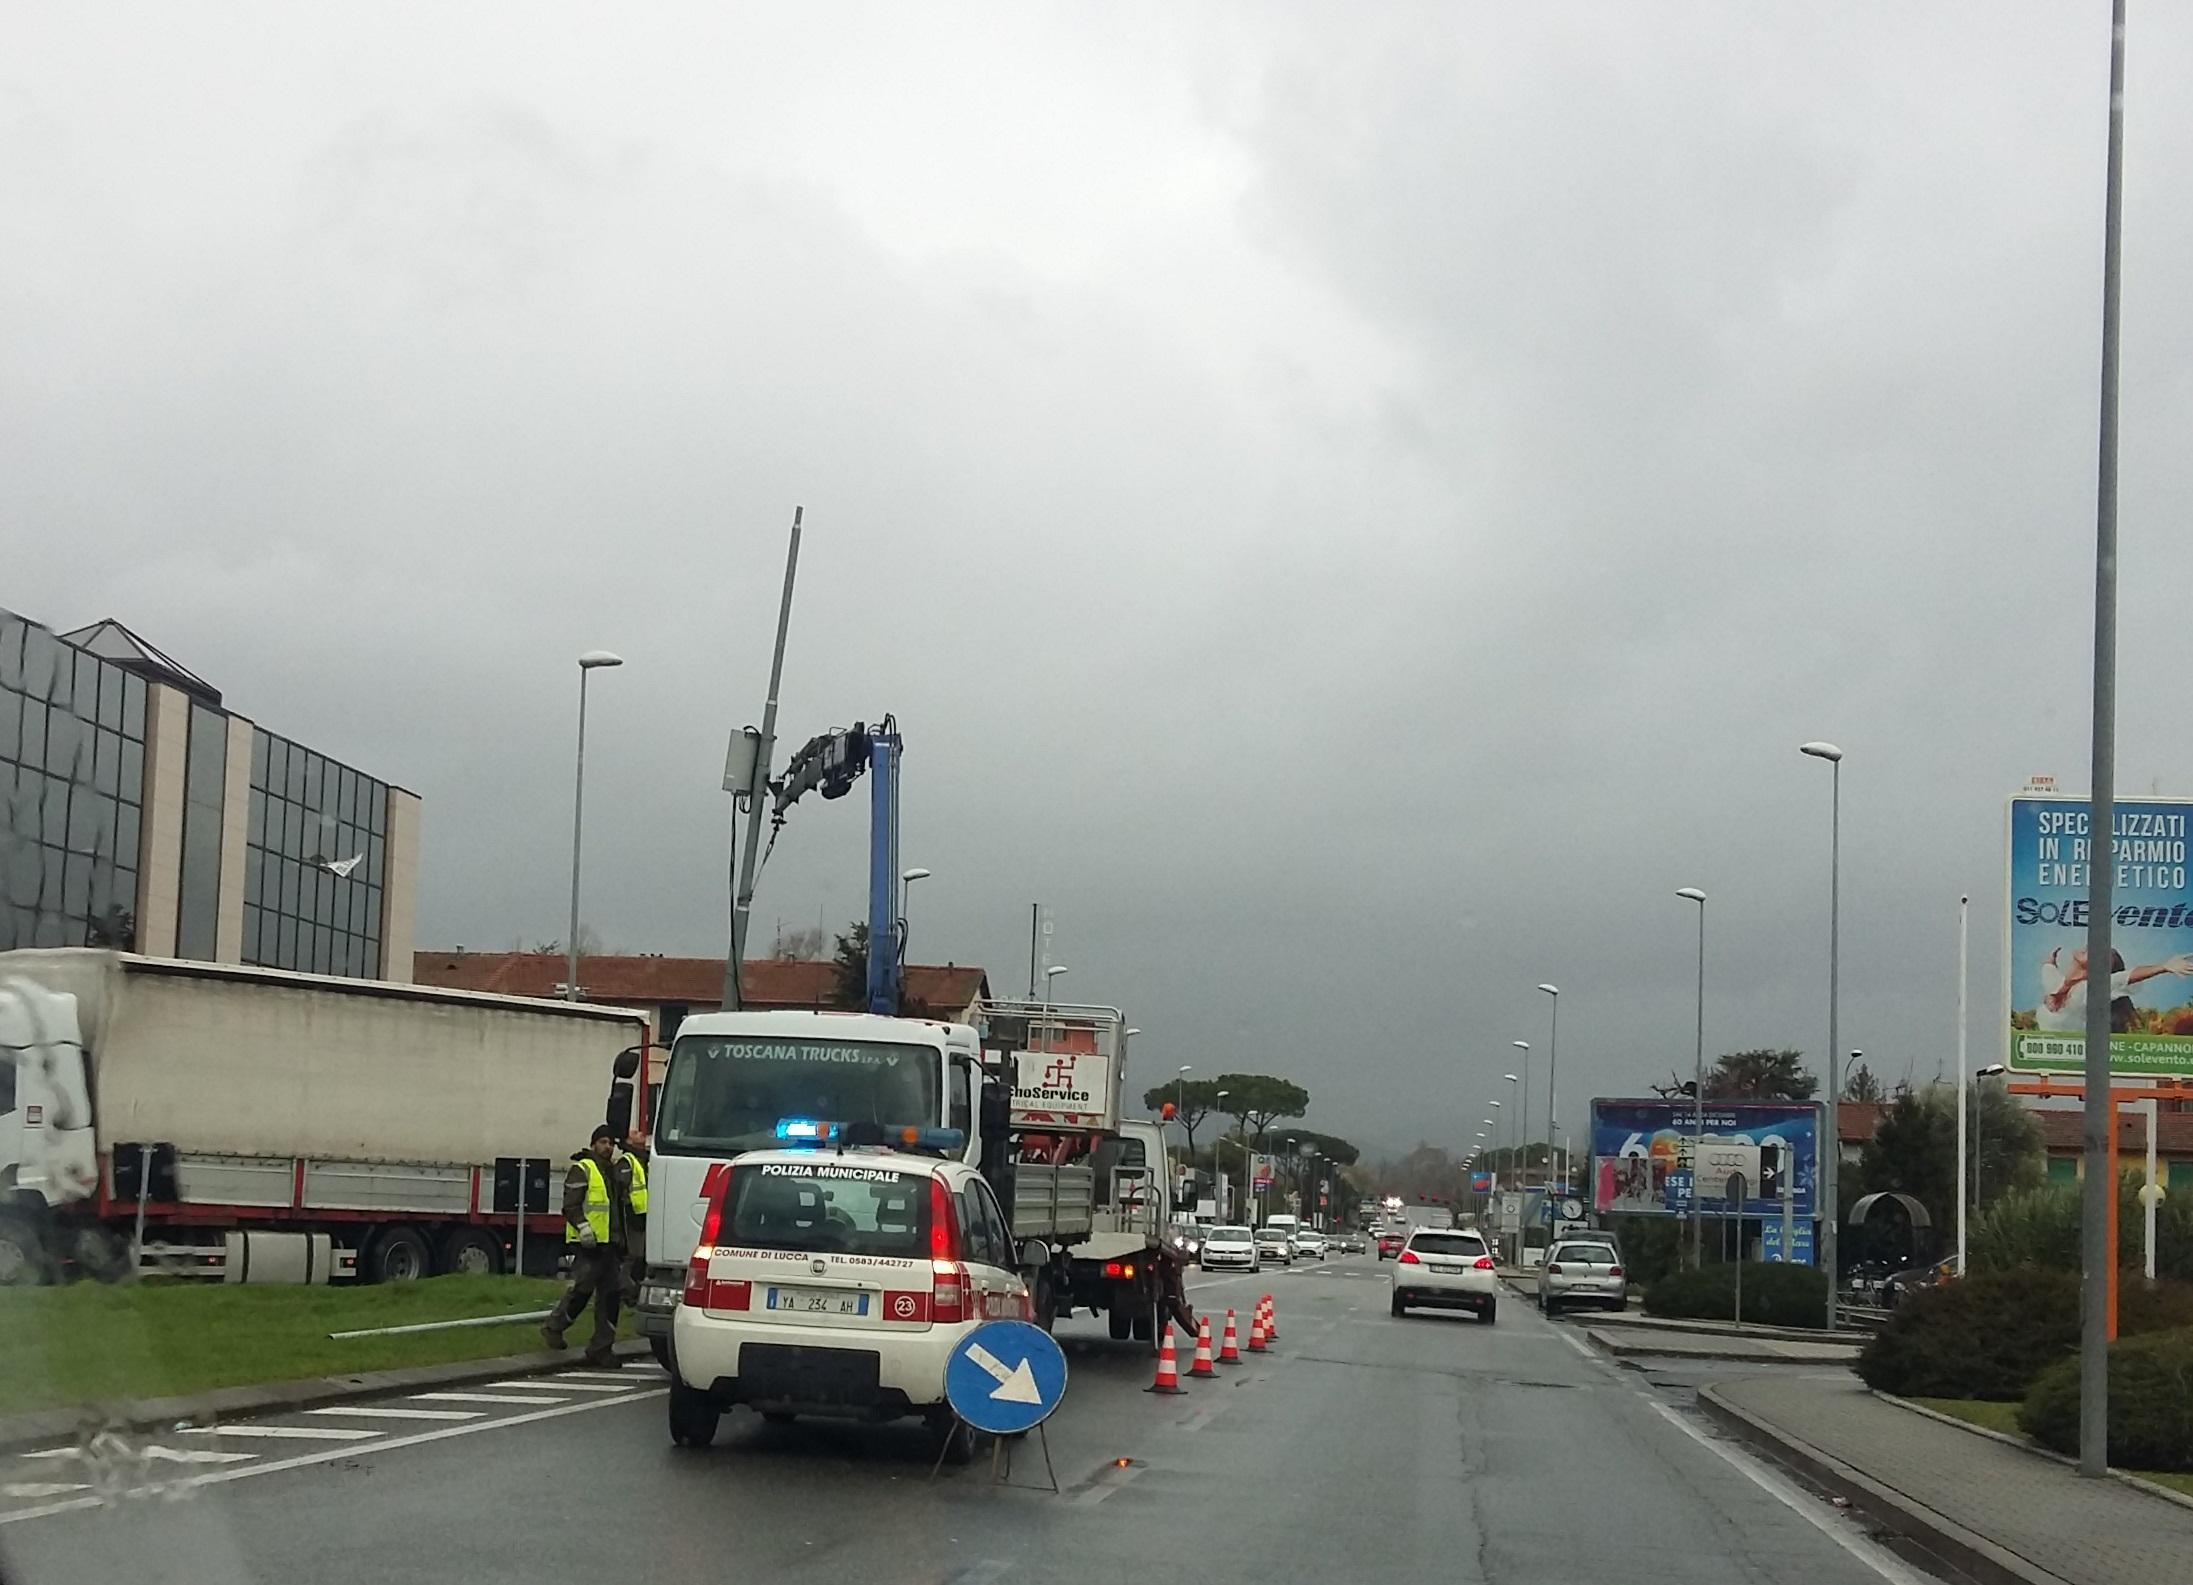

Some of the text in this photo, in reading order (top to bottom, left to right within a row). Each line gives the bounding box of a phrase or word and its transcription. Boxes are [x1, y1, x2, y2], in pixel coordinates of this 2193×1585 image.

[2038, 811, 2186, 837] SPECLIZZATI
[2038, 837, 2186, 863] IN RIPARMIO
[2038, 863, 2186, 889] ENEETICO
[724, 1044, 797, 1060] TOSCANA
[800, 1046, 861, 1063] TRUCKS
[2066, 1044, 2084, 1056] 410
[2109, 1041, 2125, 1051] NE
[2133, 1043, 2193, 1054] CAPANNO
[1721, 1119, 1737, 1127] NOI
[762, 1164, 900, 1183] POLIZIA MUNICIPALE
[714, 1249, 809, 1261] COMUNE DI LUCCA
[783, 1296, 794, 1309] YA
[808, 1297, 828, 1311] 234
[840, 1300, 854, 1313] AH
[899, 1300, 912, 1312] 23
